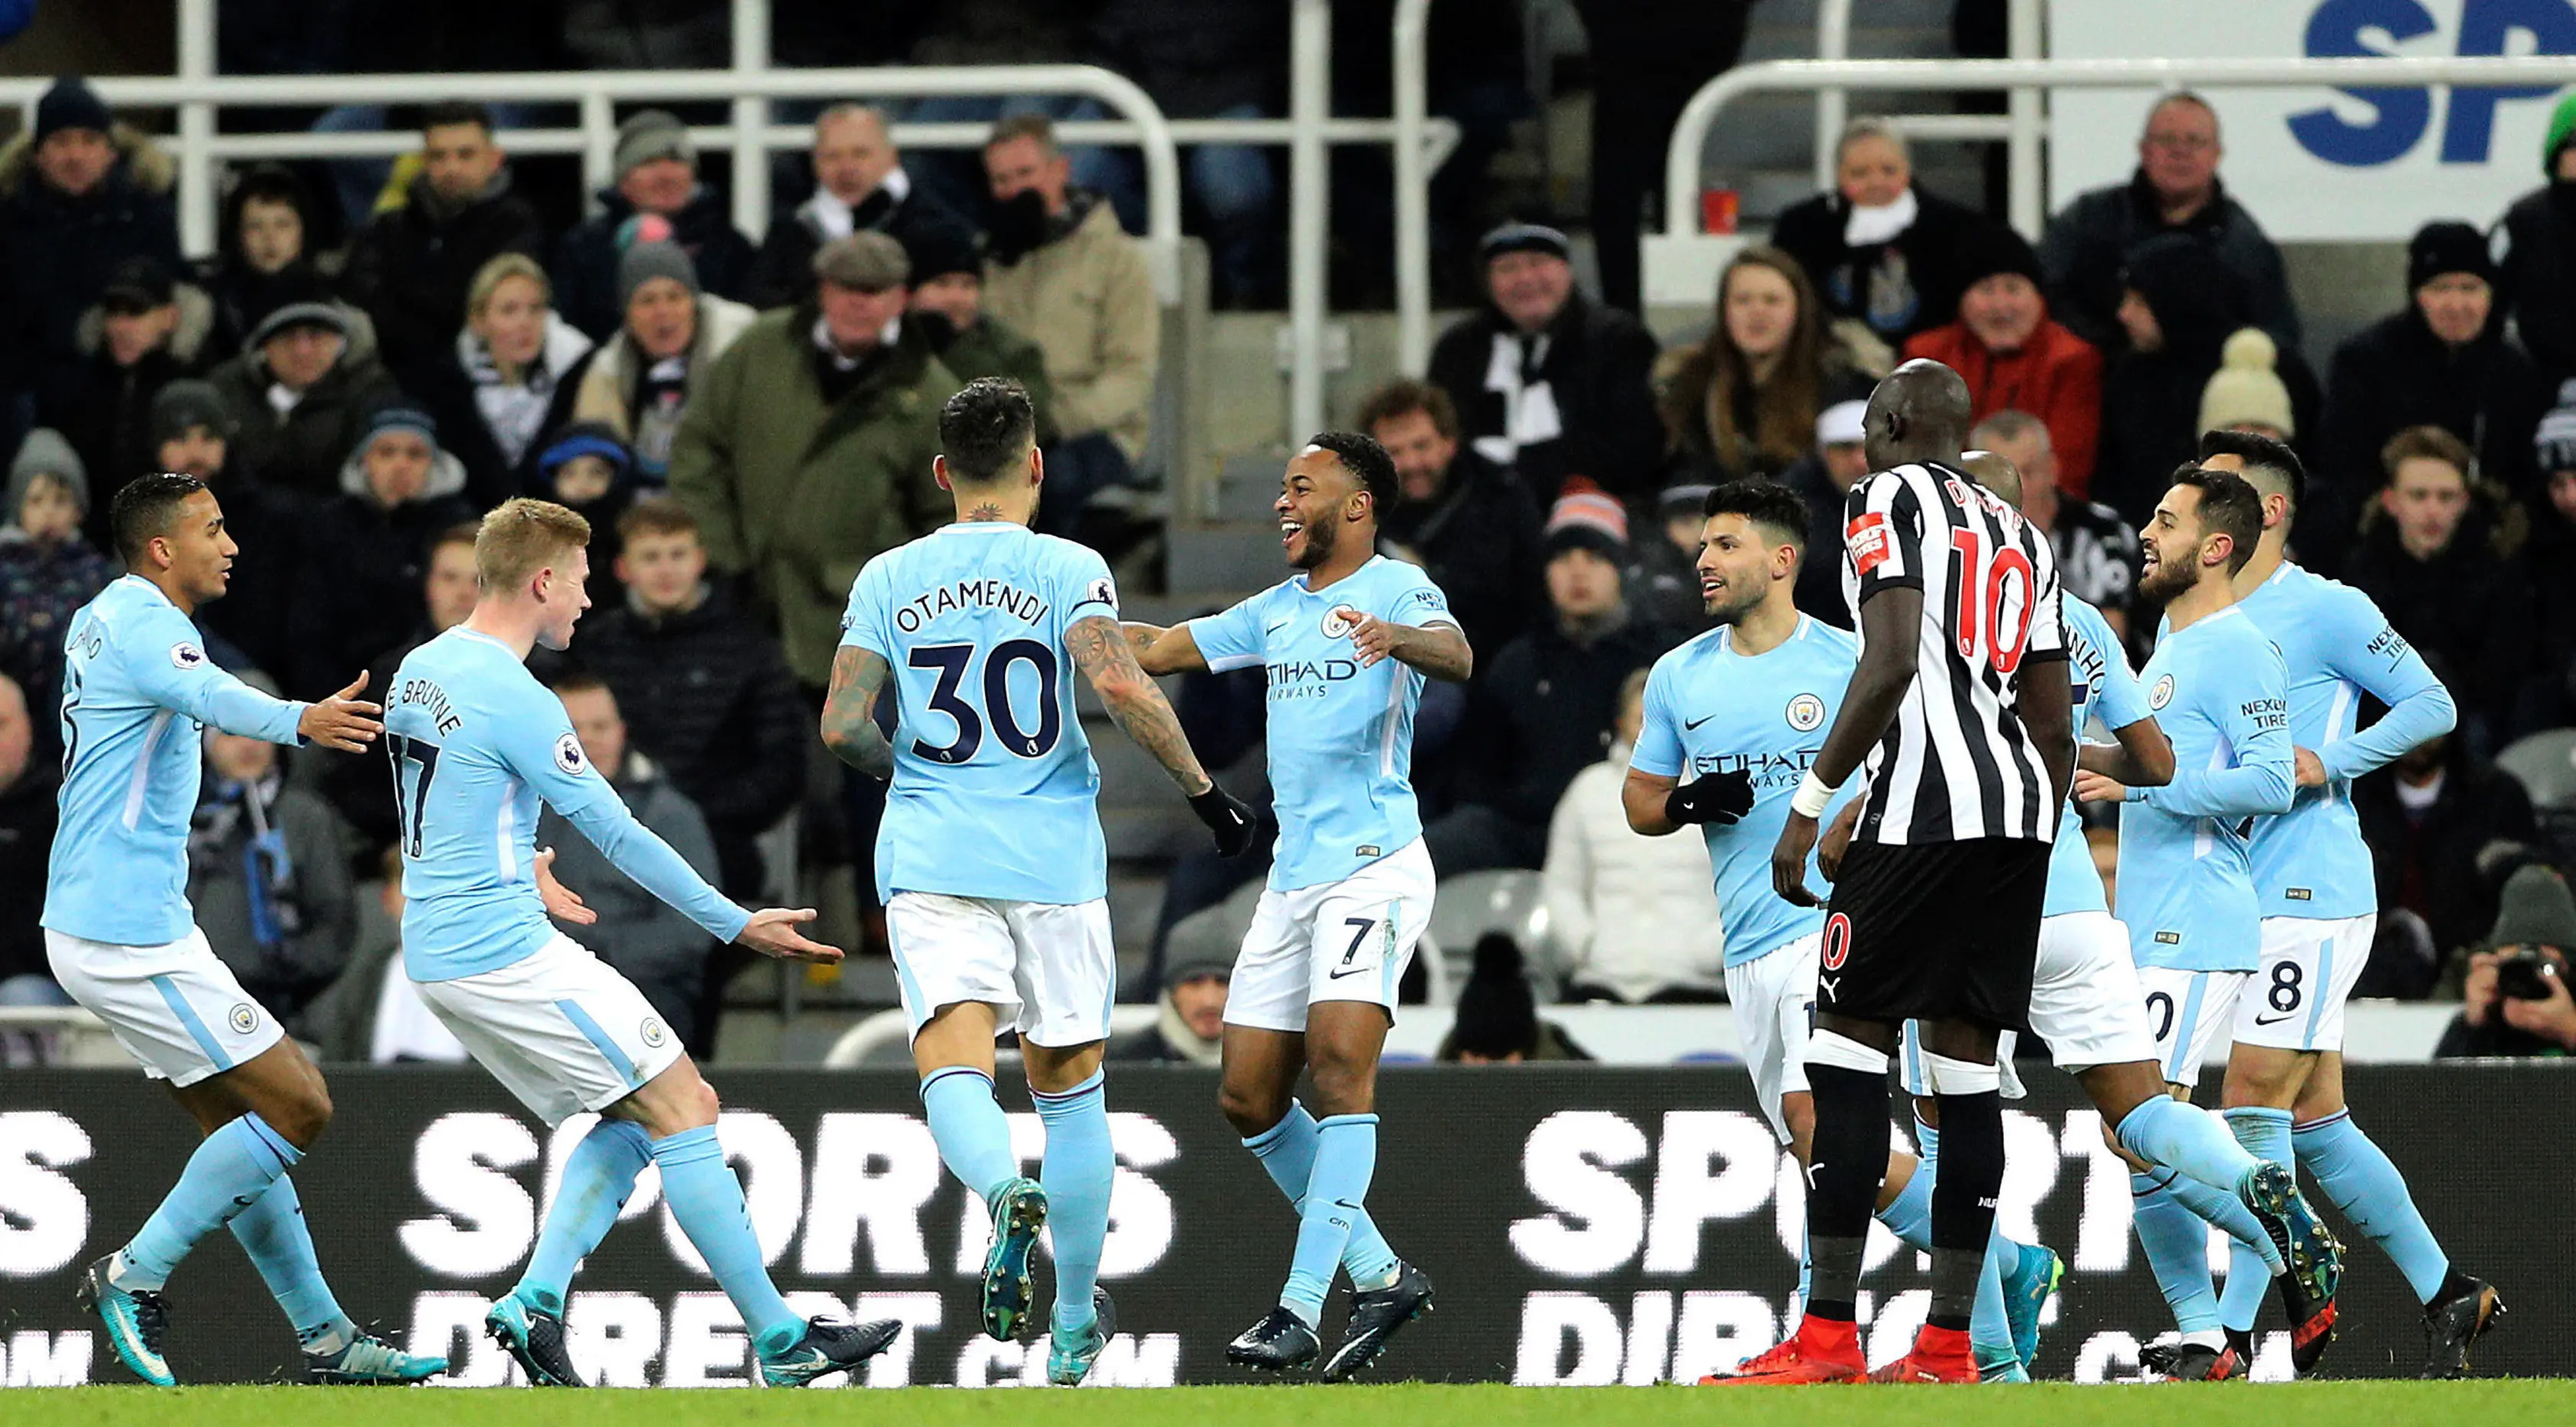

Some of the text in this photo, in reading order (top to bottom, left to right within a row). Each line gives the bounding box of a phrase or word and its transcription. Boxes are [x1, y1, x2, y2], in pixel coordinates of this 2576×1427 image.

[897, 580, 1049, 632] OTAMENDI
[1952, 527, 2034, 673] 10
[1267, 659, 1357, 686] TIHAD
[1269, 684, 1326, 701] IRWAYS
[401, 678, 462, 738] BRUYNE
[909, 639, 1061, 763] 30
[2252, 714, 2288, 729] TIRE
[387, 732, 442, 858] 17
[1342, 917, 1375, 965] 7
[1822, 912, 1852, 971] 0
[2268, 961, 2303, 1012] 8
